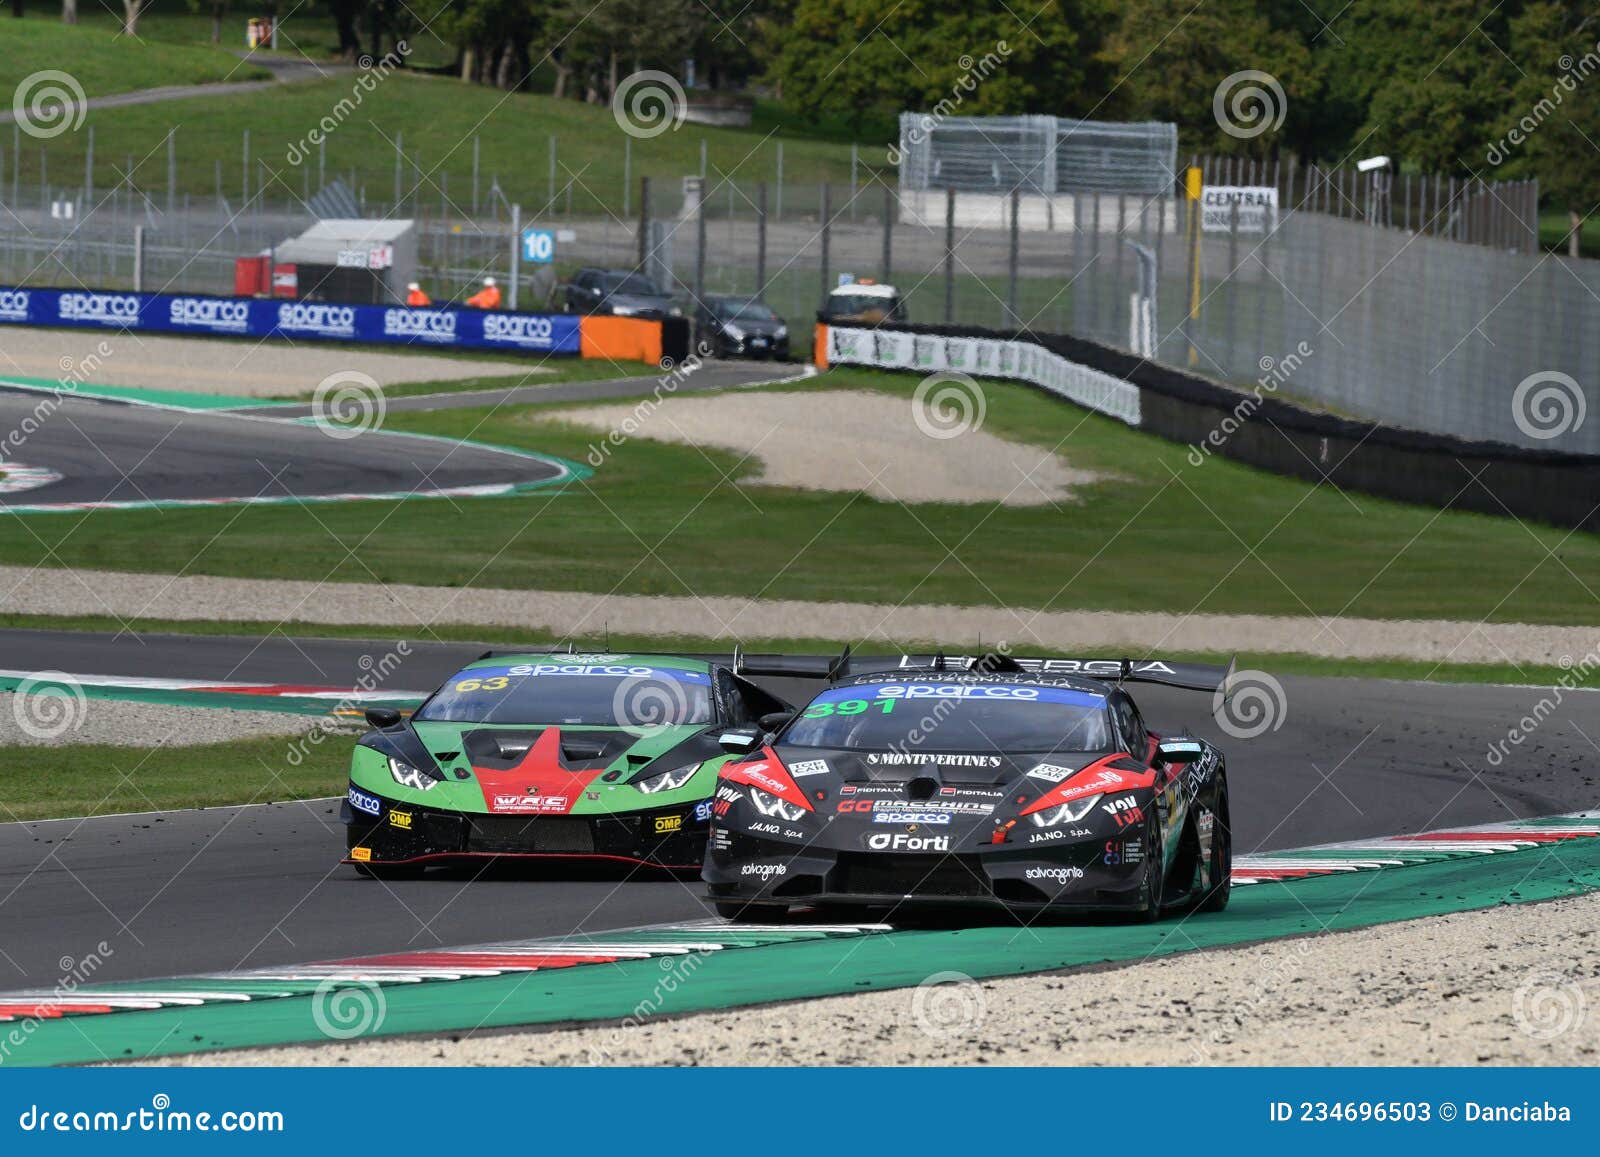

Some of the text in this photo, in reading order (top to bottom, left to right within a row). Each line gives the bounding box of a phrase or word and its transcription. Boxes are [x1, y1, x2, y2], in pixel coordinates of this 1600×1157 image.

[1205, 191, 1271, 207] CENTRAL
[525, 232, 551, 258] 10
[58, 293, 140, 317] sparco
[169, 298, 248, 323] sparco
[278, 303, 354, 327] sparco
[384, 308, 456, 332] sparco
[483, 314, 551, 338] sparco
[507, 664, 654, 678] sparco
[455, 676, 510, 693] 63
[877, 684, 1039, 700] sparco
[803, 698, 896, 719] 391
[794, 761, 822, 769] TOP
[956, 789, 1004, 797] FIDITALIA
[837, 800, 874, 813] GG
[390, 812, 412, 827] OMP
[655, 816, 681, 831] OMP
[874, 812, 951, 824] sparco
[893, 834, 950, 850] Forti
[1029, 830, 1067, 843] JA.NO.
